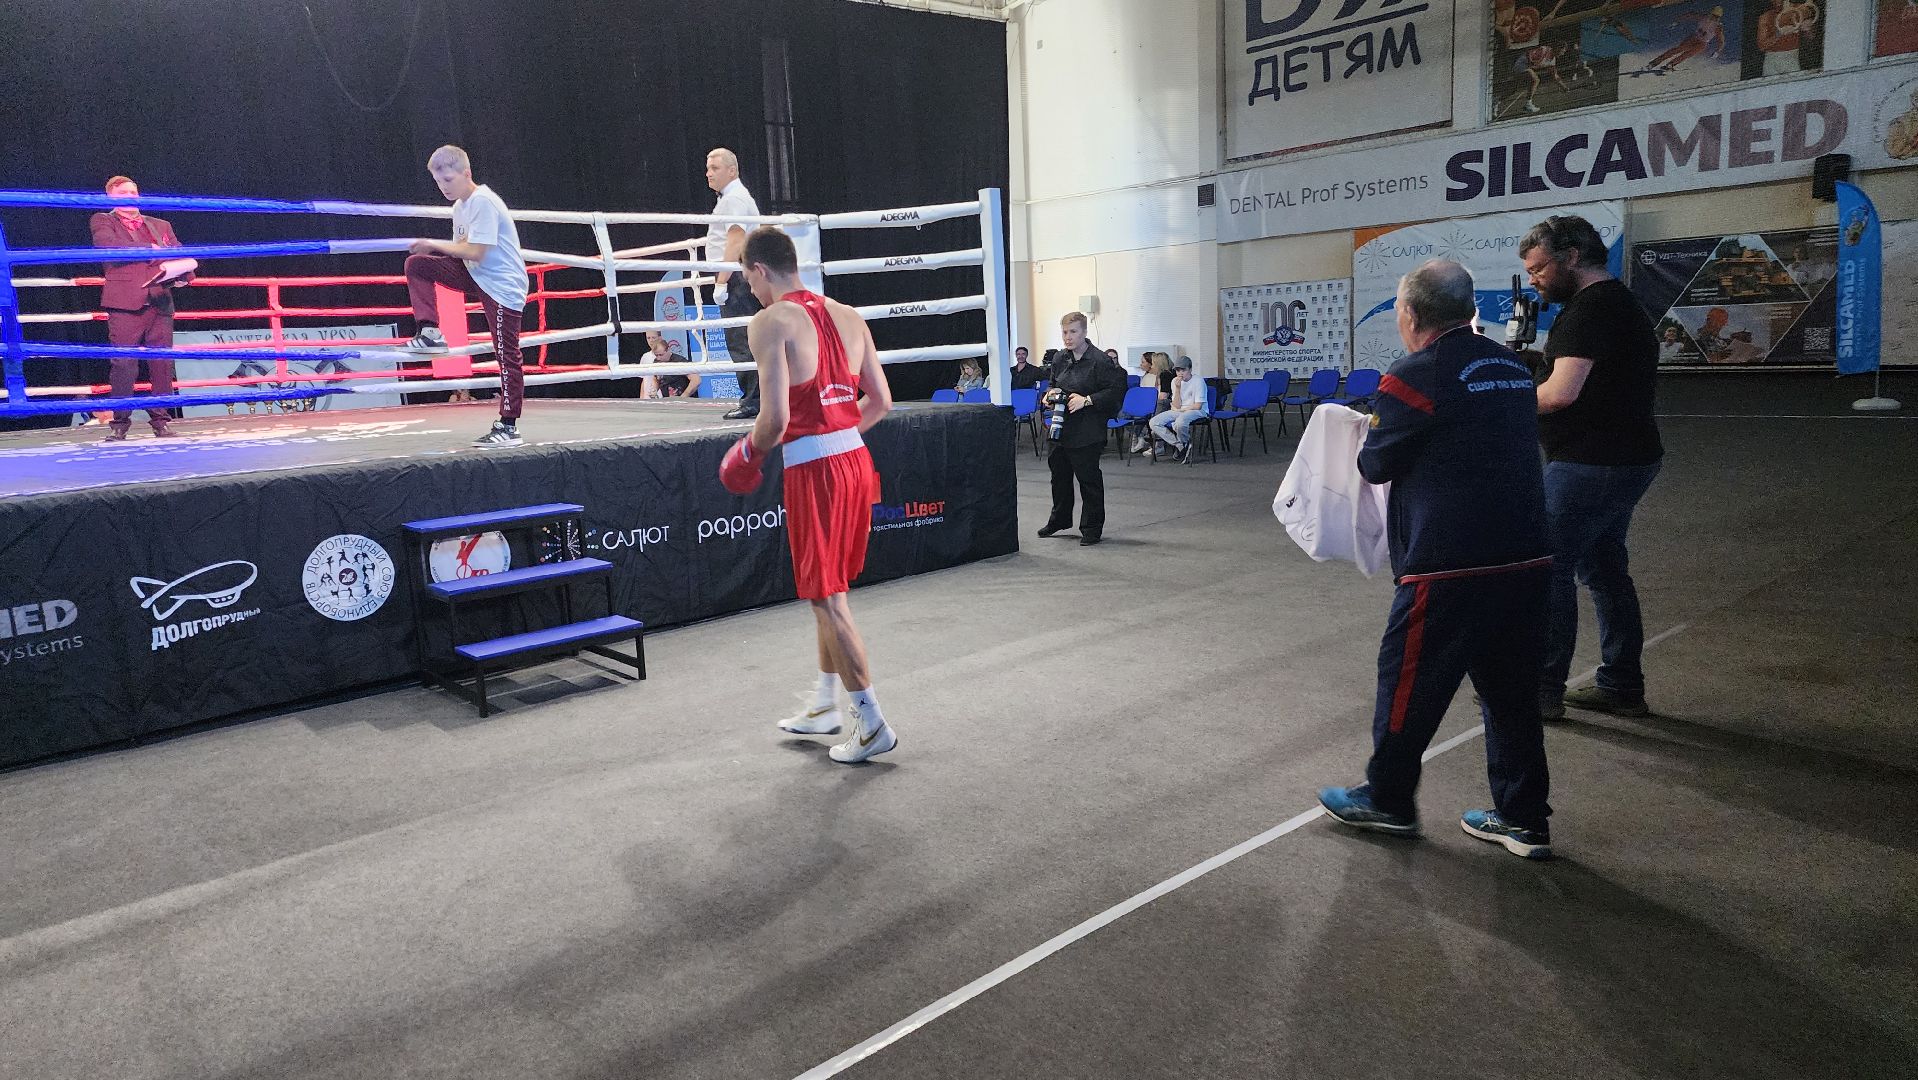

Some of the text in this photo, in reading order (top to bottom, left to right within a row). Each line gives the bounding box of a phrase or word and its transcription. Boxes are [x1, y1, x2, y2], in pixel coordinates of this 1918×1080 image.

[1248, 22, 1422, 106] ДЕТЯМ
[1445, 99, 1849, 202] SILCAMED
[1230, 174, 1429, 215] DENTAL Prof Systems
[880, 211, 920, 222] ADEGMA
[1392, 245, 1433, 260] САЛЮТ
[1475, 235, 1520, 252] САЛЮТ
[884, 256, 923, 267] ADEGMA
[889, 304, 928, 316] ADEGMA
[602, 525, 670, 553] САЛЮТ
[306, 536, 387, 576] ДОЛГОПРУДНЫЙ
[376, 566, 392, 599] СОЮЗ
[0, 634, 85, 665] ystems
